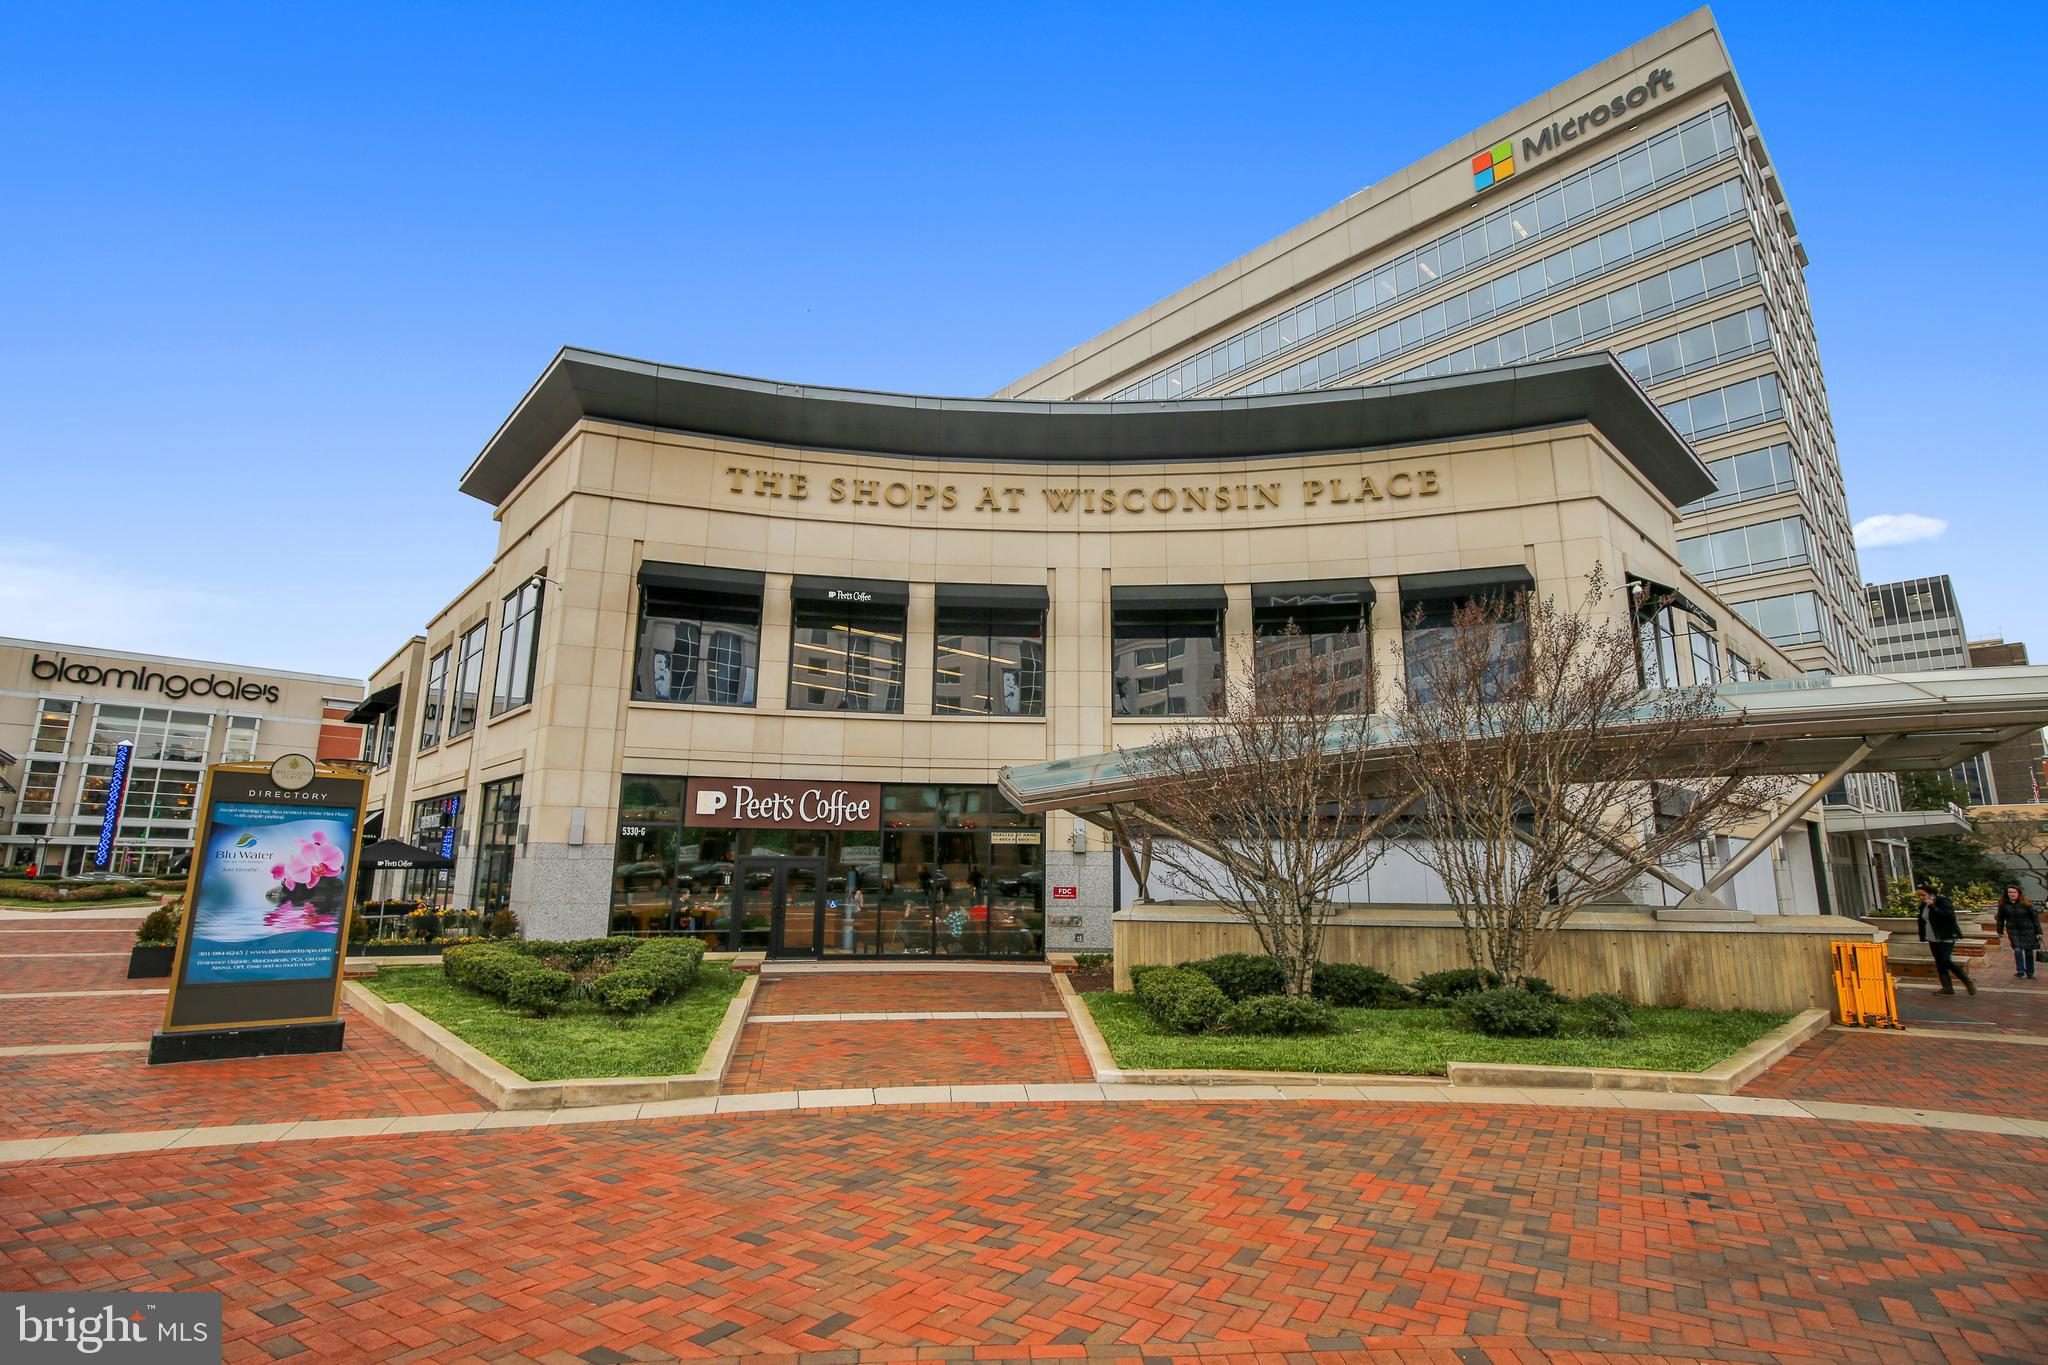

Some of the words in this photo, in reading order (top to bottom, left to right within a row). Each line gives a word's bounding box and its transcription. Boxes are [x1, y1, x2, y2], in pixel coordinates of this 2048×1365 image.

[1521, 67, 1675, 161] Microsoft
[726, 466, 809, 499] THE
[830, 478, 958, 511] SHOPS
[974, 486, 1025, 512] AT
[1042, 482, 1282, 513] WISCONSIN
[1302, 468, 1441, 505] PLACE
[853, 591, 872, 602] Coffee
[31, 653, 280, 702] bloomingdale's
[248, 789, 328, 801] DIRECTORY
[732, 785, 795, 822] Peet's
[799, 788, 871, 827] Coffee
[622, 826, 646, 837] 5330-G
[216, 850, 237, 859] Blu
[239, 850, 274, 860] Water
